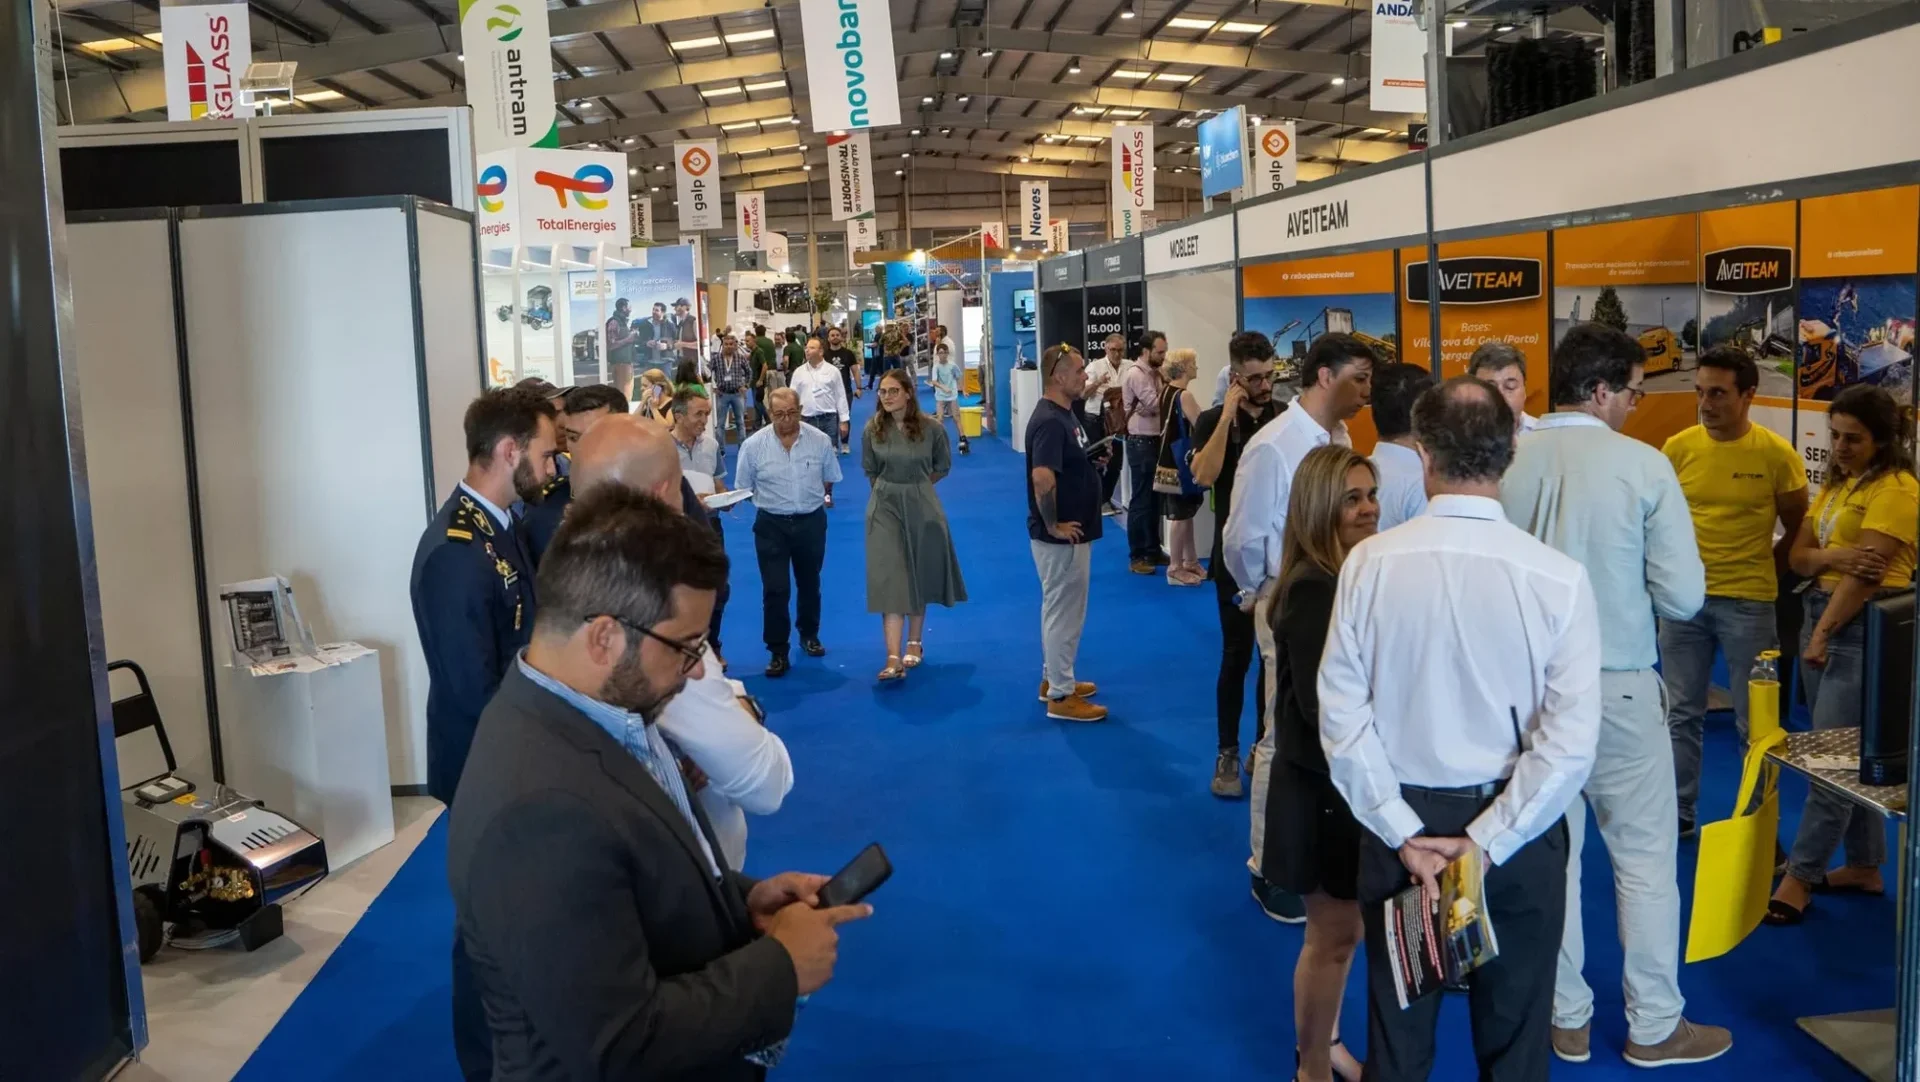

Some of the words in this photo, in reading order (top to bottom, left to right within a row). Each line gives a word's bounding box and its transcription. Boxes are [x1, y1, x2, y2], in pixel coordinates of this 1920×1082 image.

[507, 49, 527, 135] antram
[839, 144, 852, 213] TRANSPORTE
[852, 168, 861, 203] NACIONAL
[1134, 131, 1143, 207] CARGLASS
[1269, 160, 1283, 190] galp
[690, 179, 708, 211] galp
[537, 218, 616, 234] TotalEnergies
[751, 197, 759, 249] CARGLASS
[1030, 188, 1041, 236] Nieves
[1287, 200, 1349, 238] AVEITEAM
[1169, 234, 1199, 259] MOBLEET
[1717, 258, 1779, 280] AVEITEAM
[1461, 322, 1492, 333] Bases:
[1464, 335, 1475, 346] de
[1504, 332, 1539, 347] (Porto)
